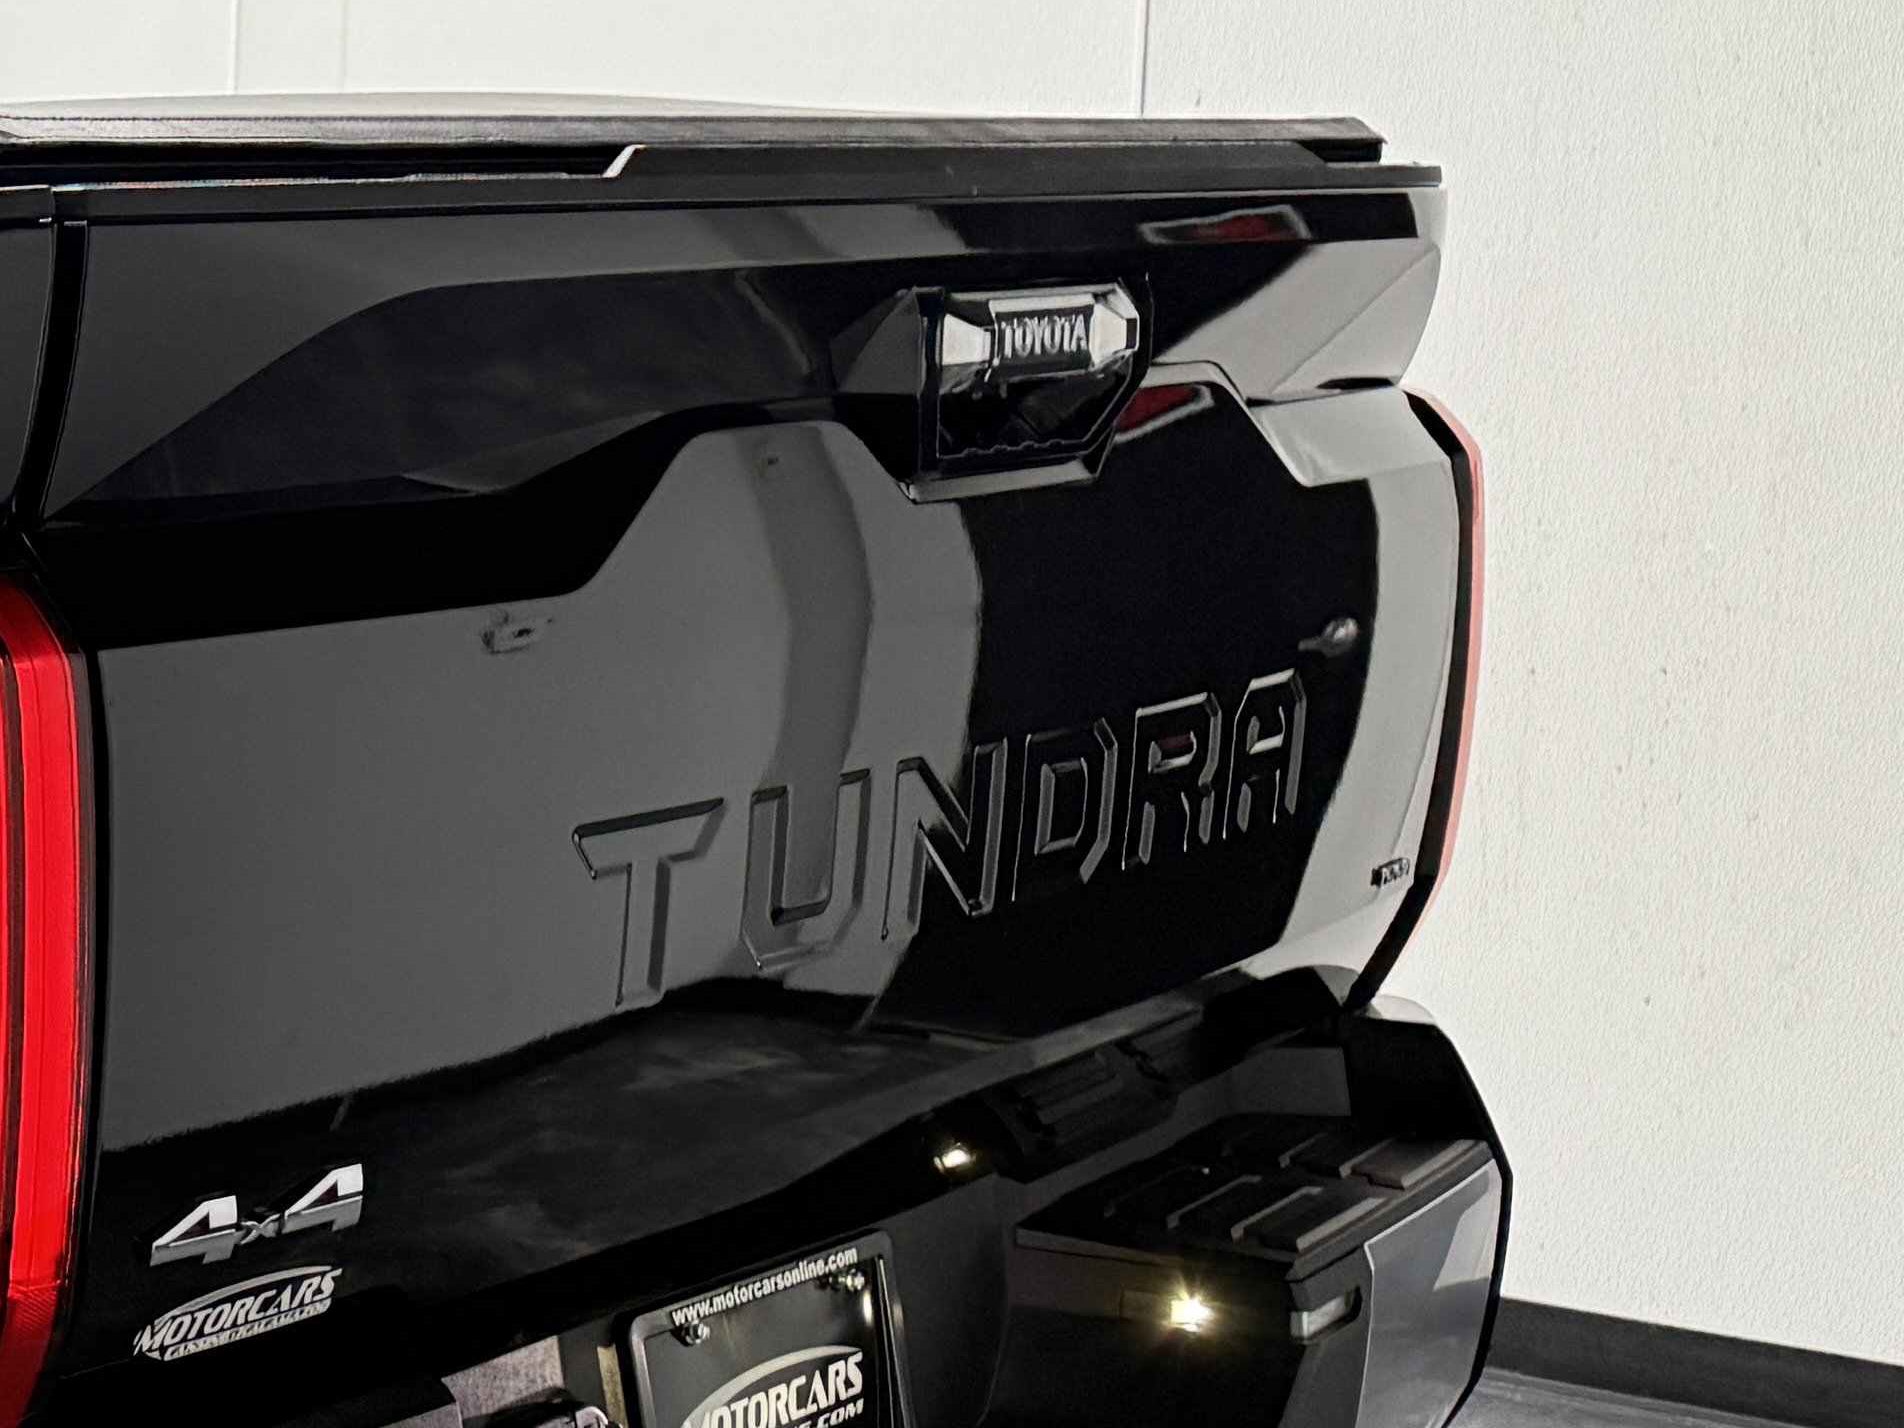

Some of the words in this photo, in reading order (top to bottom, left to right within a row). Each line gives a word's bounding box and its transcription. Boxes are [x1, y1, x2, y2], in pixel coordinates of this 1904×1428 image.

[1001, 314, 1088, 359] TOYOTA
[571, 667, 1306, 1006] TUNDRA
[133, 1267, 342, 1356] MOTORCARS
[672, 1247, 858, 1326] www.motorcarsonline.com
